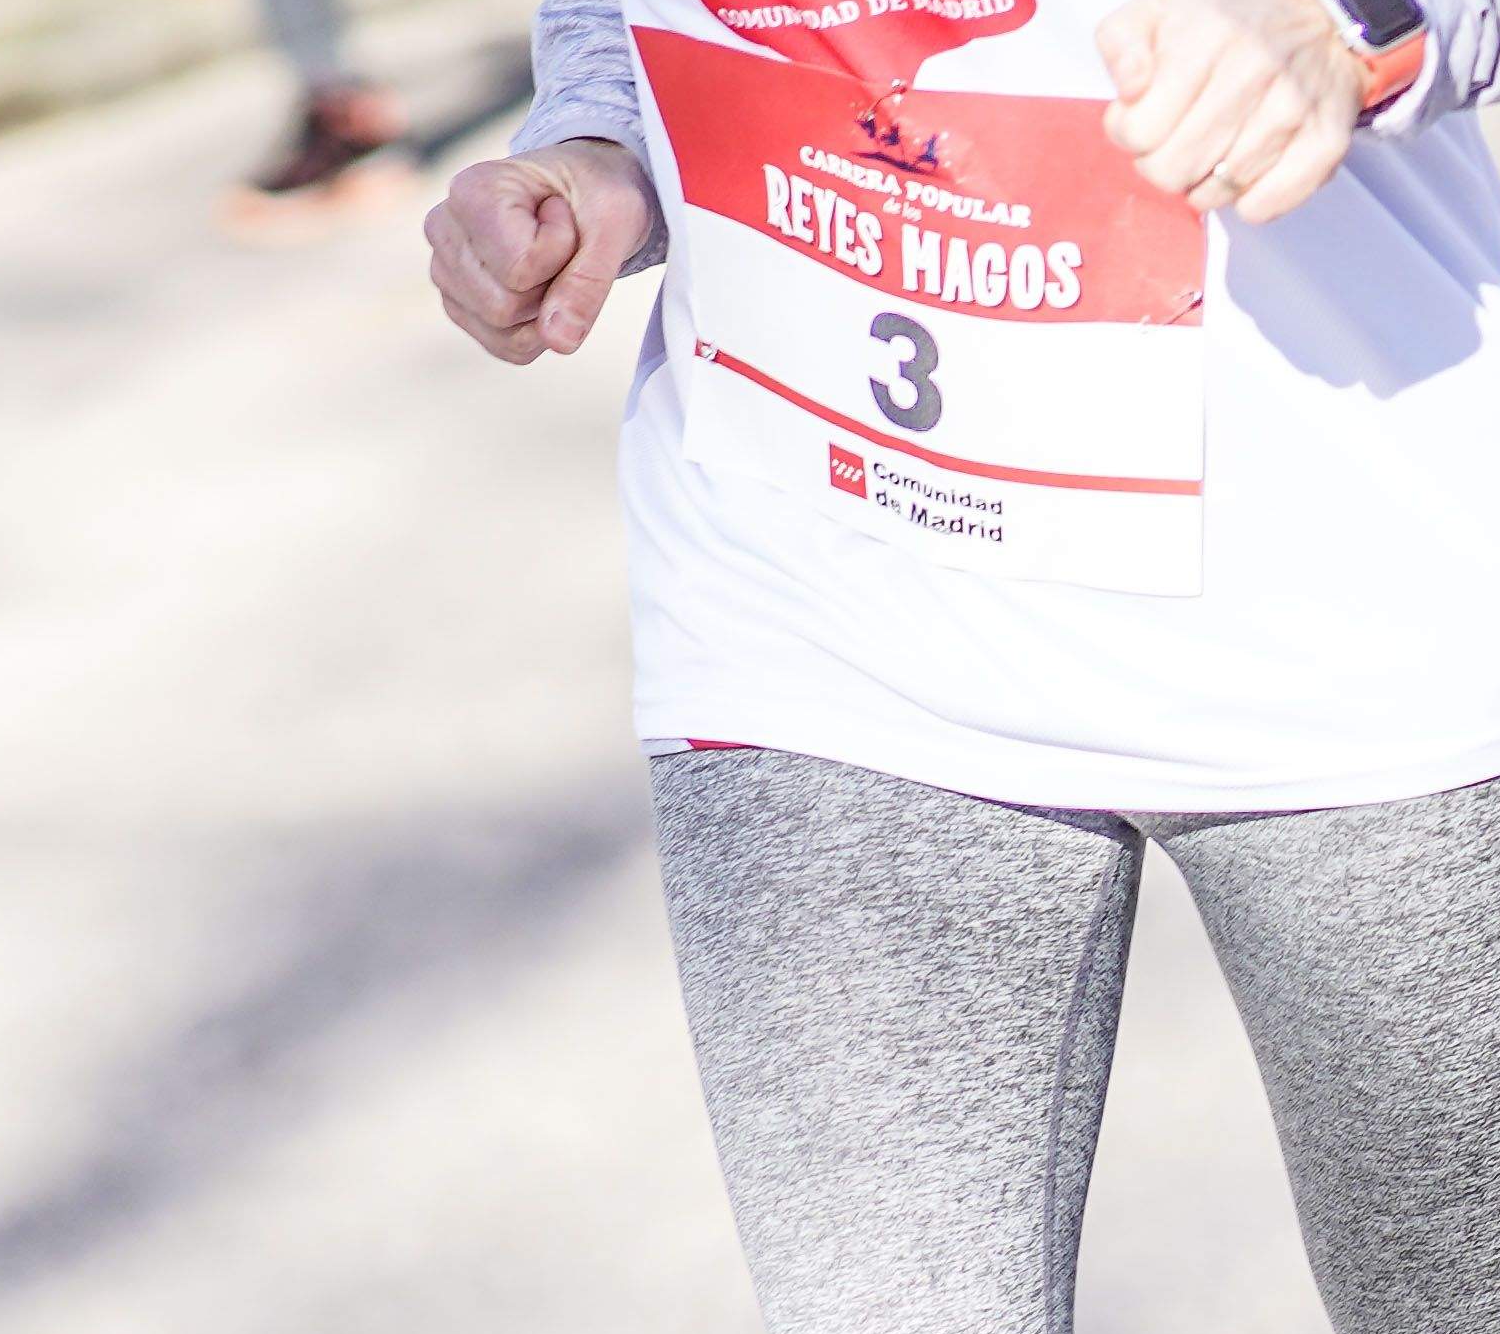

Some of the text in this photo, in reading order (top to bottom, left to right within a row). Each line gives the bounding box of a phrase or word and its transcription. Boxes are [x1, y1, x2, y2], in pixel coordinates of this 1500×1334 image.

[799, 145, 1032, 229] CARRERA POPULAR
[762, 163, 1083, 310] REYES MAGOS
[868, 312, 942, 432] 3
[873, 462, 1002, 515] Comunidad
[876, 489, 1002, 542] de Madrid
